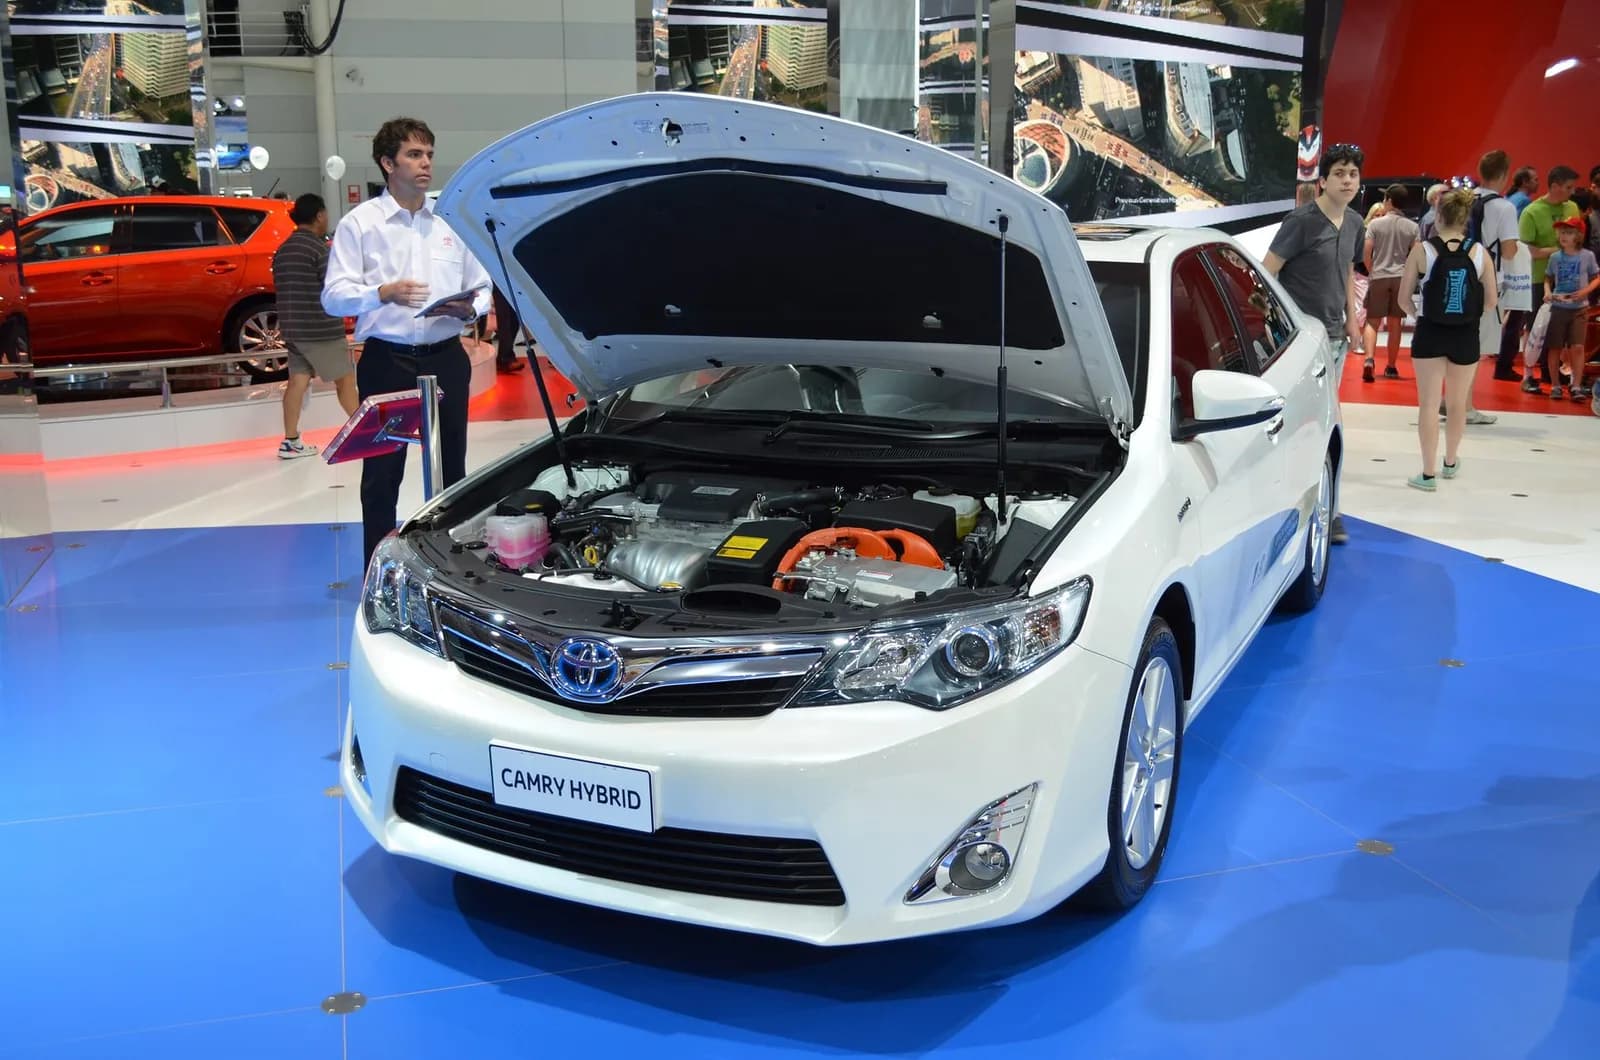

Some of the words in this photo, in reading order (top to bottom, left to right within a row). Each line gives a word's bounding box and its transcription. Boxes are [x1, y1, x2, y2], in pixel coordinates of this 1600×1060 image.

[1445, 268, 1467, 313] LONSDALE
[501, 768, 565, 797] CAMRY
[570, 779, 641, 810] HYBRID
